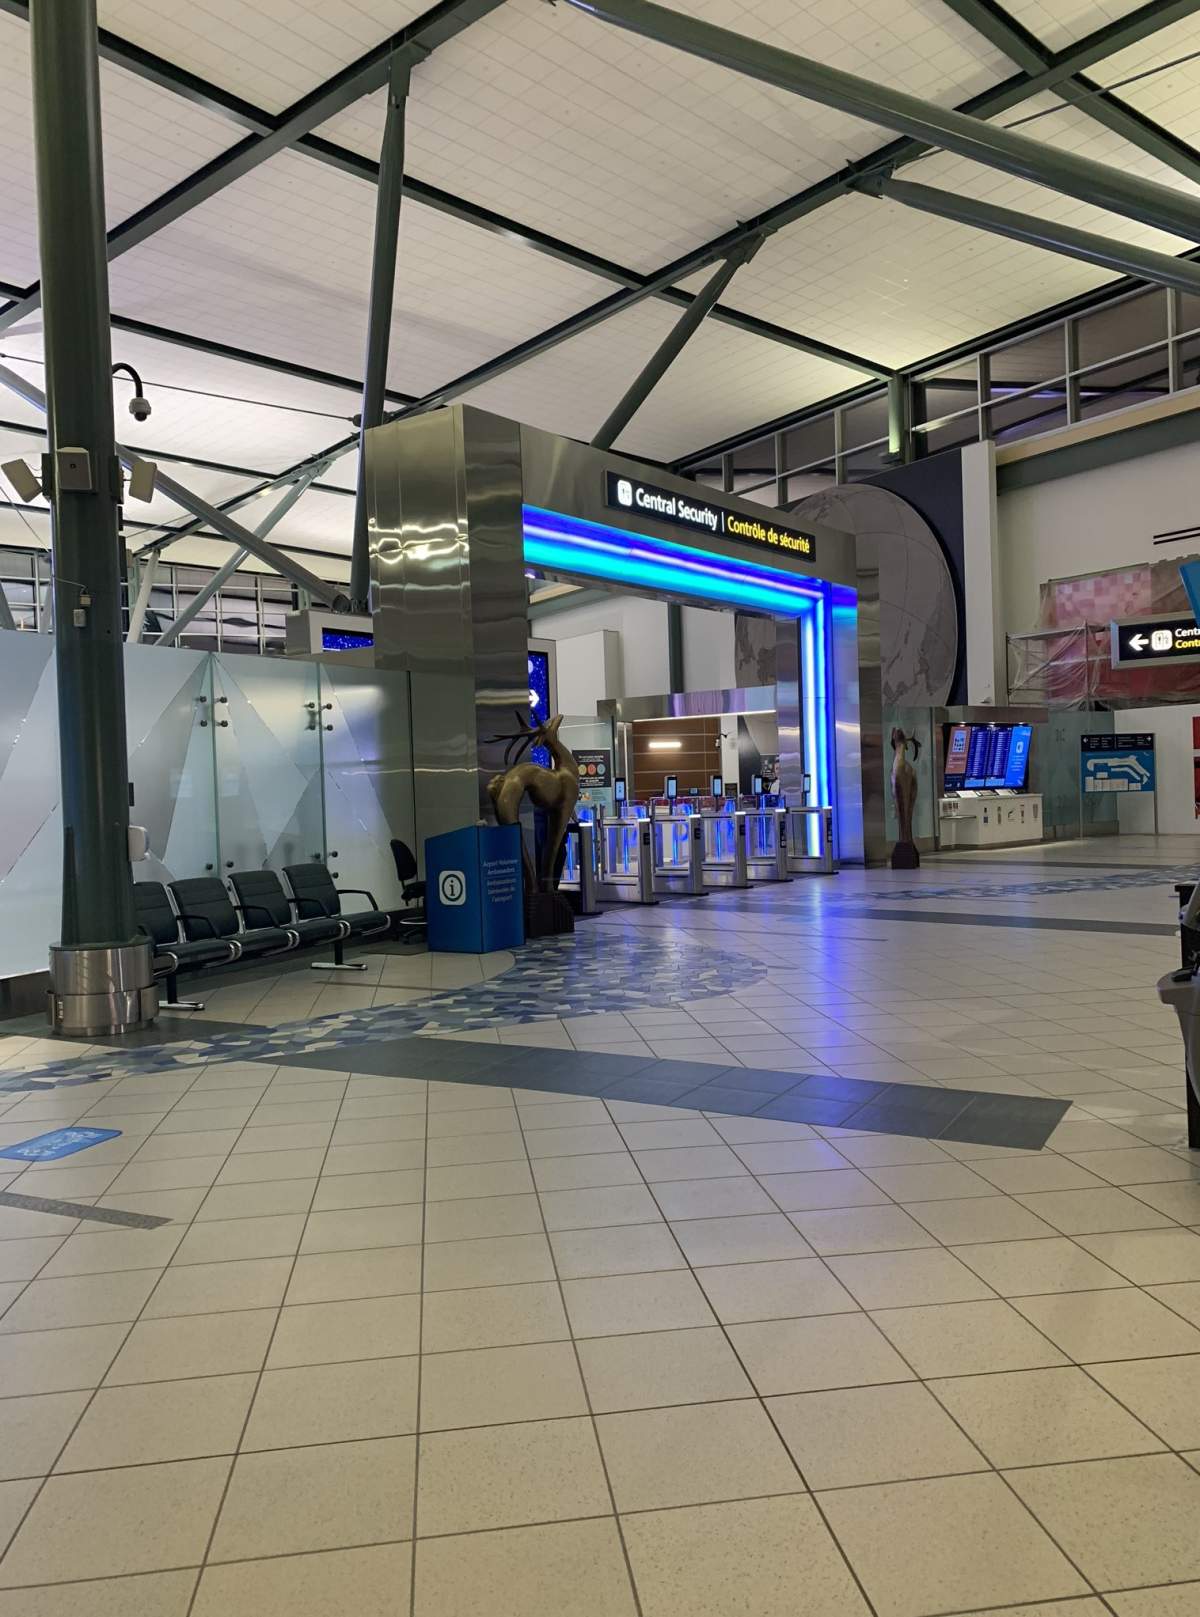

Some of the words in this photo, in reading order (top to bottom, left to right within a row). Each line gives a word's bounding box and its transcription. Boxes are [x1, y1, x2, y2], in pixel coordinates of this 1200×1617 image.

[635, 488, 676, 516] Central
[678, 500, 718, 531] Security
[727, 515, 766, 541] Contrôle
[767, 527, 779, 545] de
[779, 531, 811, 554] sécurité
